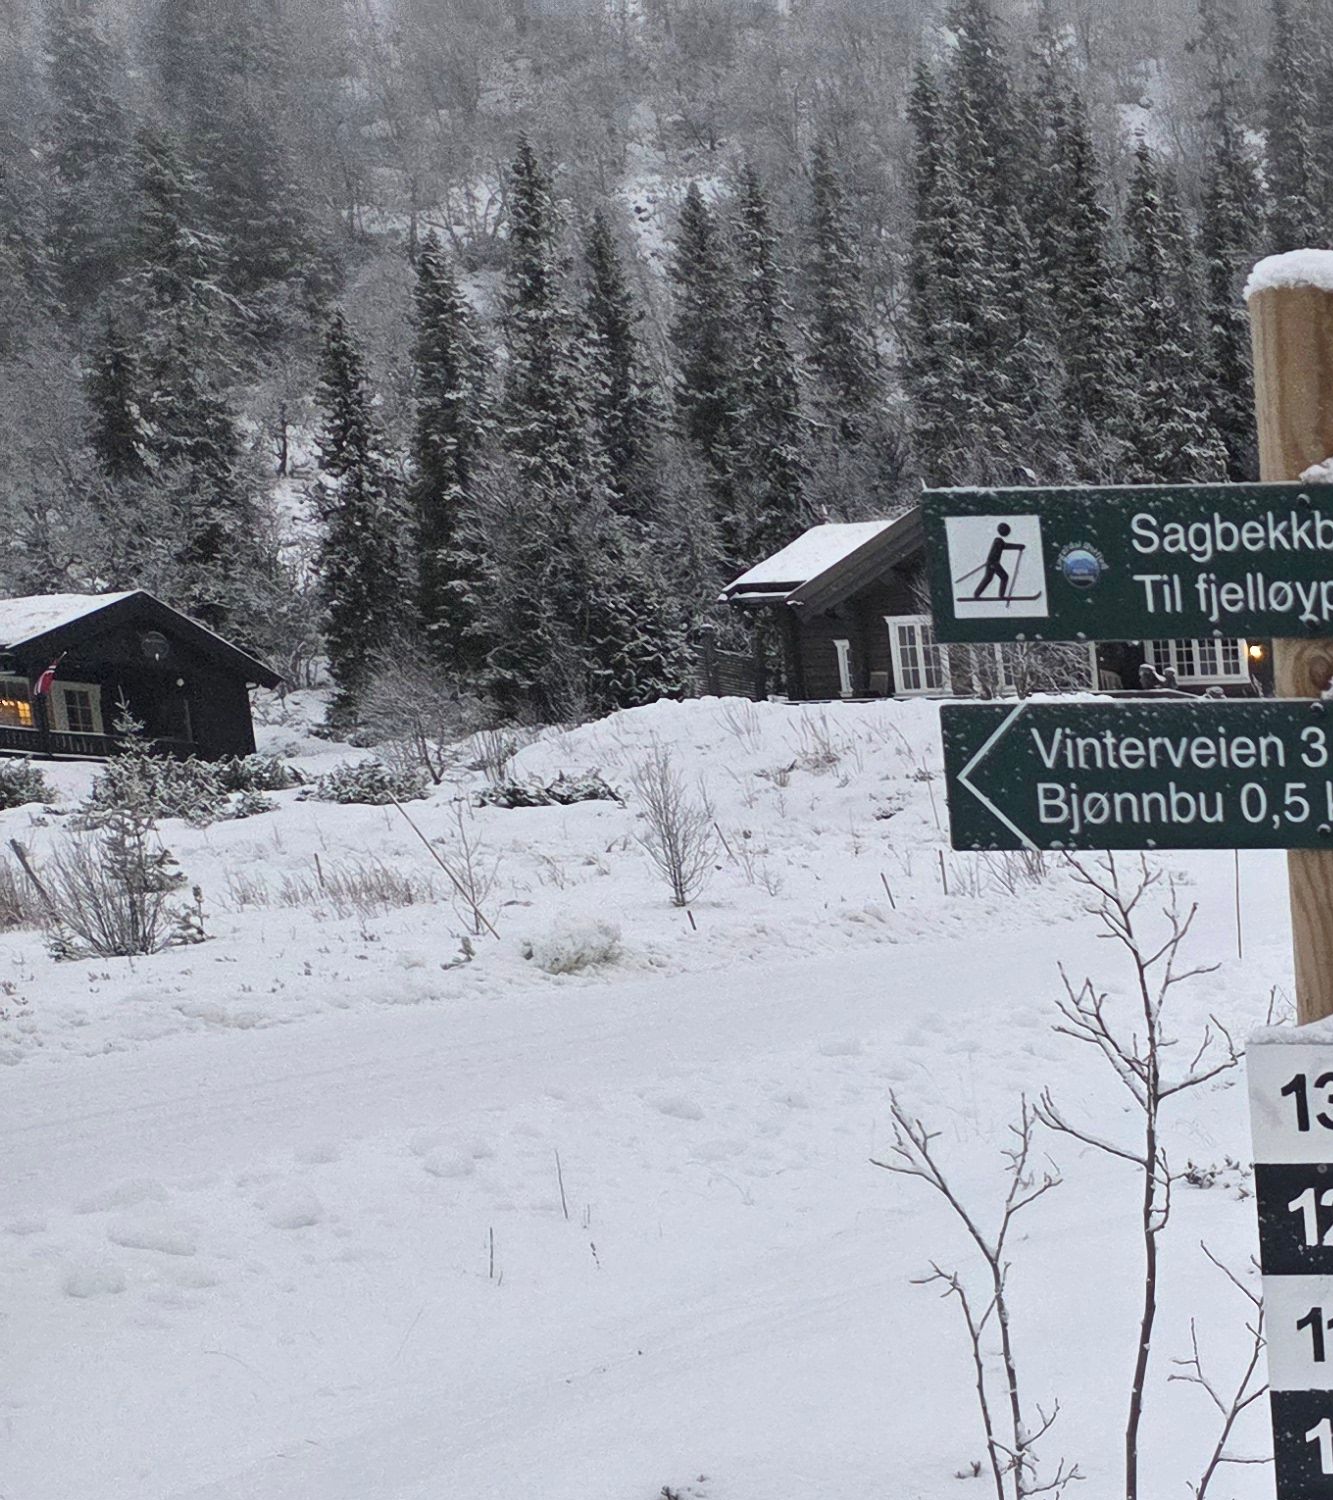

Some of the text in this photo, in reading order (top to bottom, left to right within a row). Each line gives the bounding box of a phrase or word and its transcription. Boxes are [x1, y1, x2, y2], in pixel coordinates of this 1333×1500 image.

[1133, 574, 1182, 613] Til
[1031, 727, 1285, 769] Vinterveien
[1301, 726, 1328, 767] 3
[1037, 781, 1224, 834] Bjønnbu
[1240, 783, 1310, 829] 0,5
